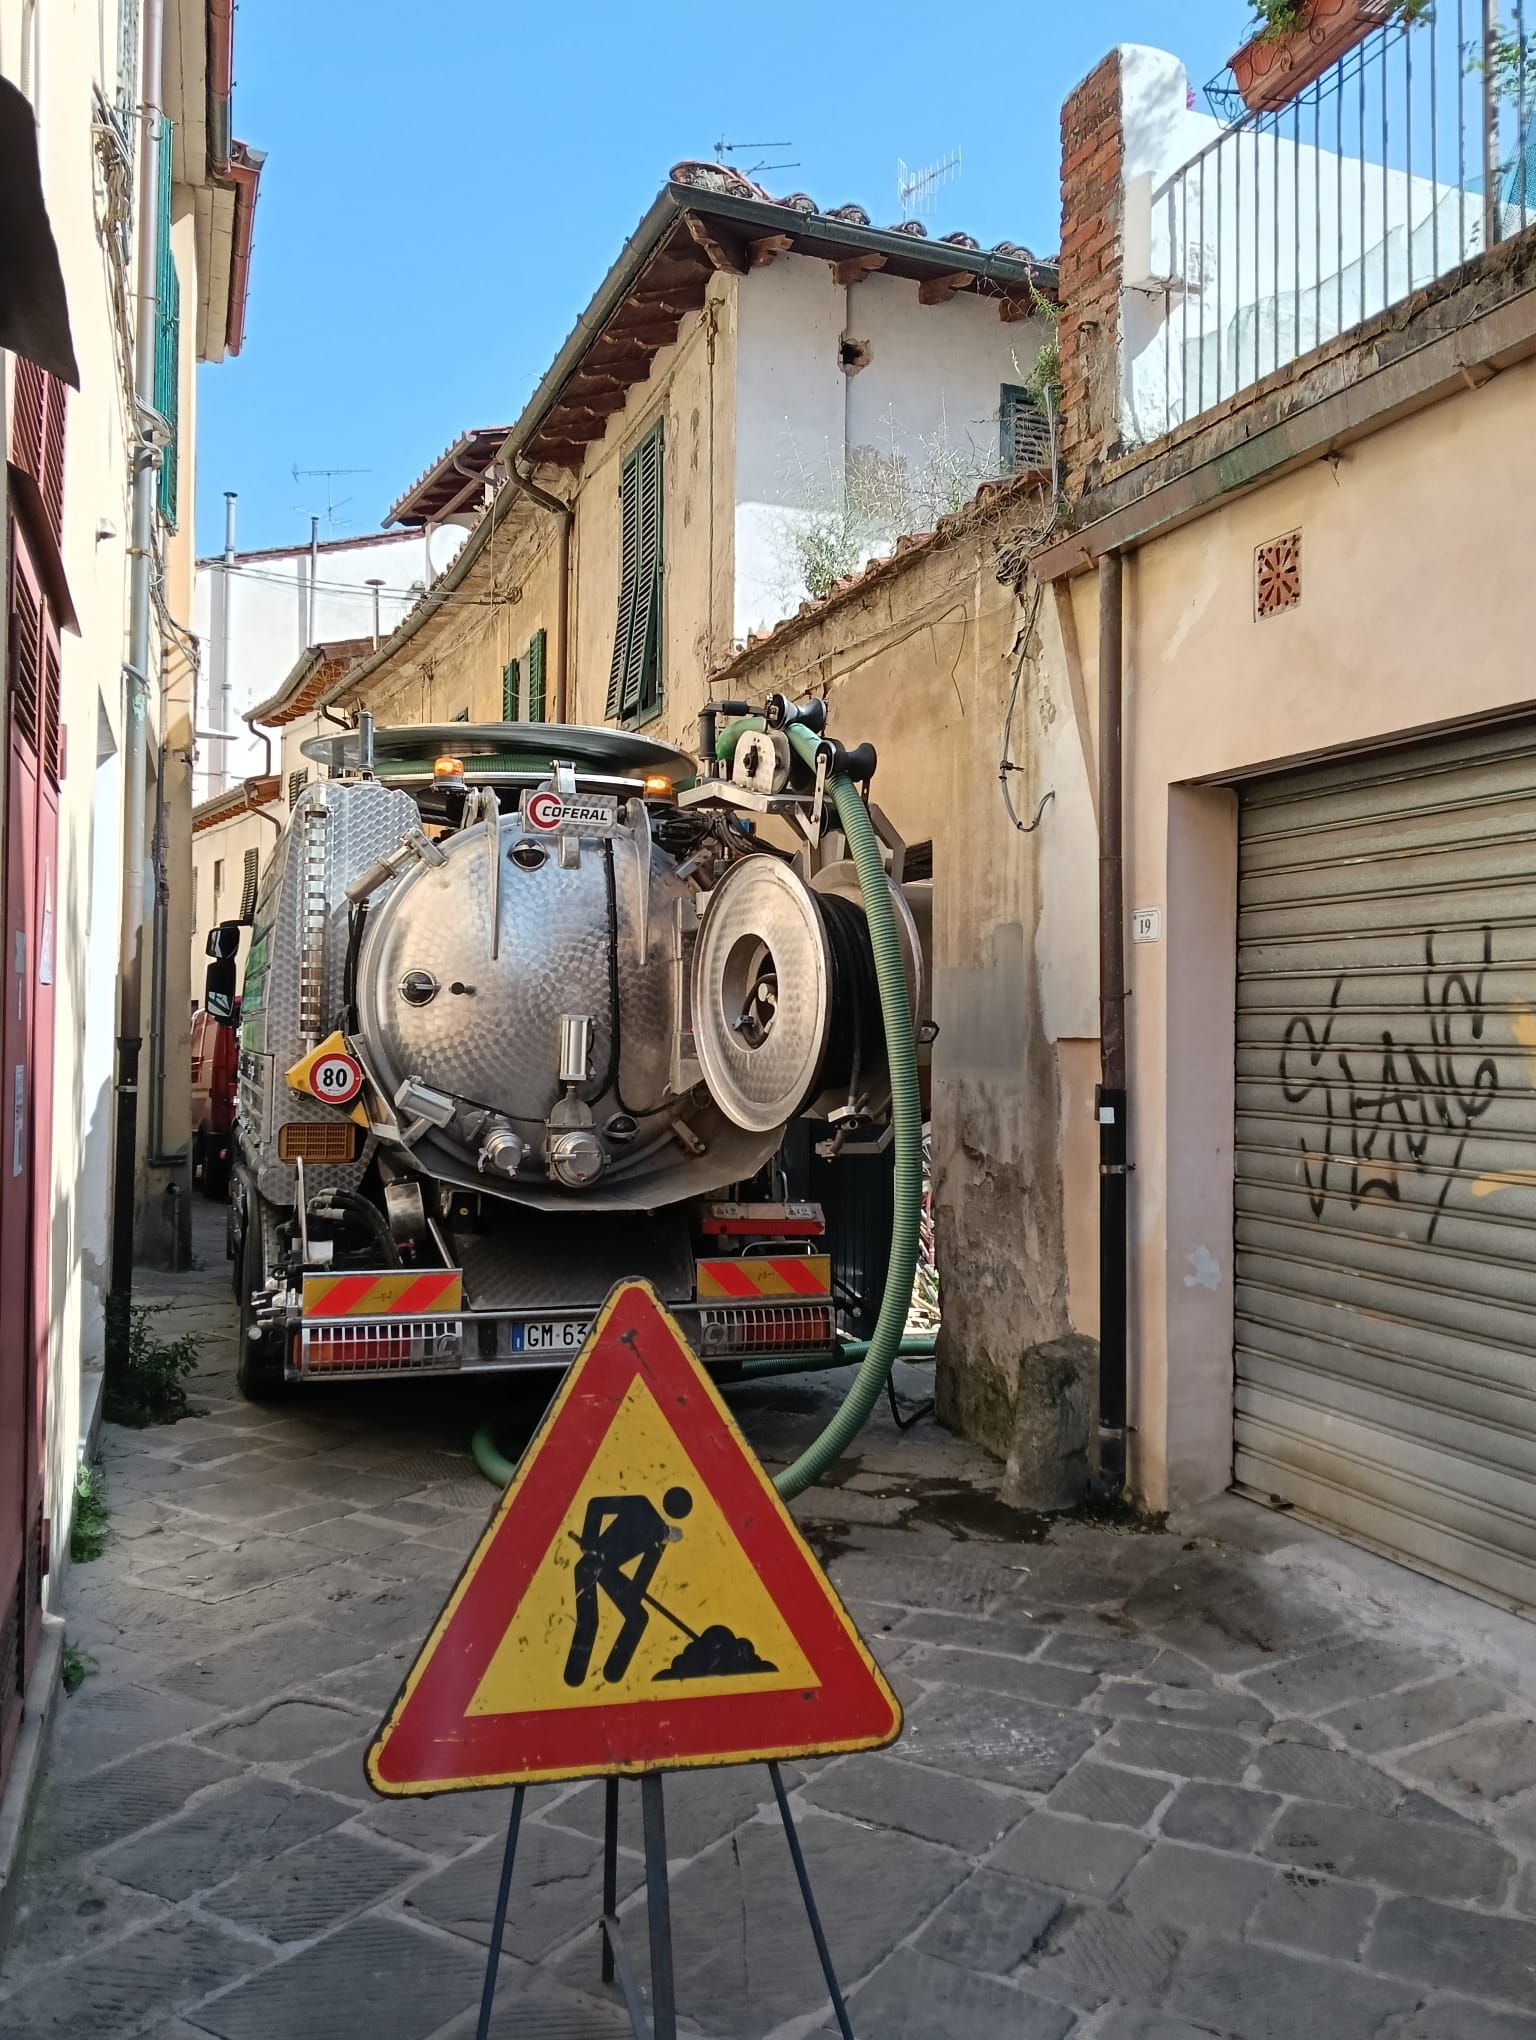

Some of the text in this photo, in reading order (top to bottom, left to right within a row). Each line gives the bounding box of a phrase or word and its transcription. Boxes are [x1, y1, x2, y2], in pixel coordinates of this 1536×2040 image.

[542, 805, 608, 821] COFERAL
[1140, 918, 1151, 934] 19
[322, 1067, 348, 1088] 80
[527, 1322, 589, 1348] GM 63
